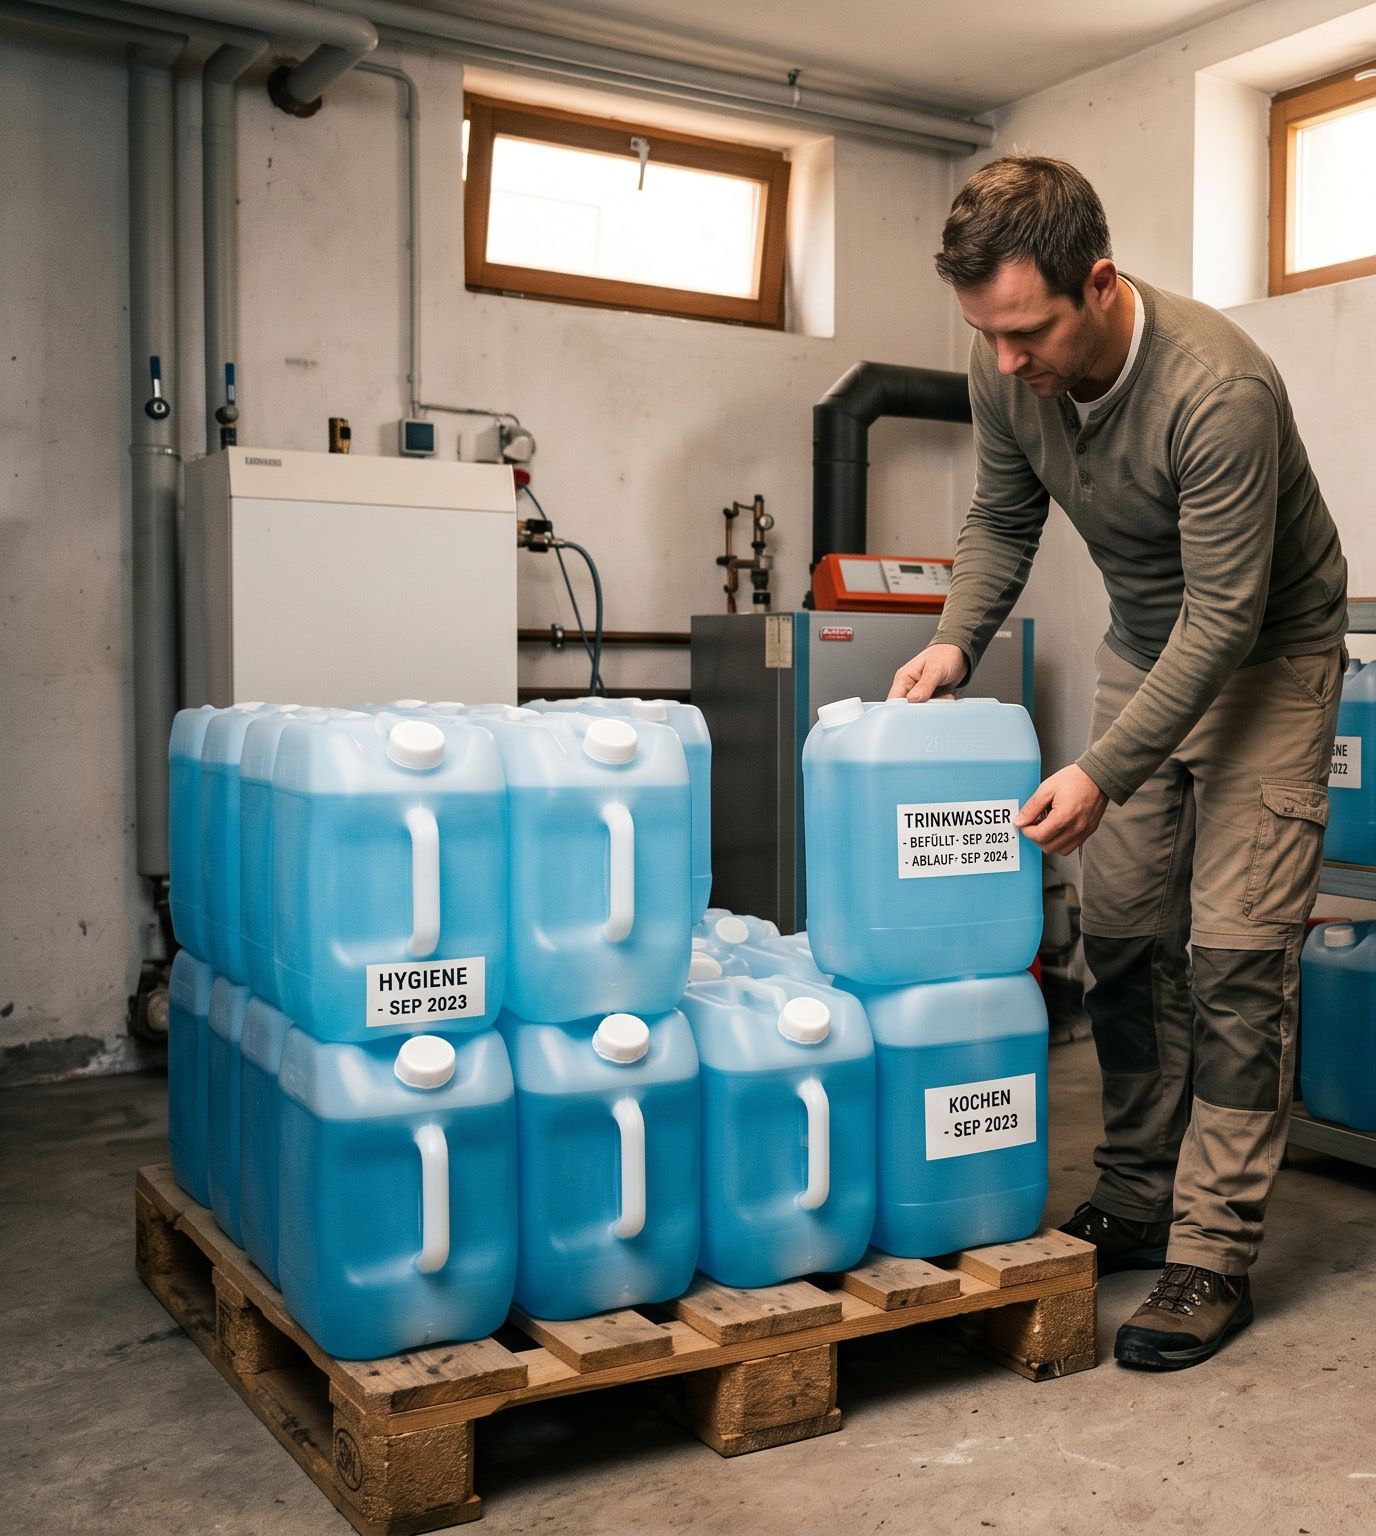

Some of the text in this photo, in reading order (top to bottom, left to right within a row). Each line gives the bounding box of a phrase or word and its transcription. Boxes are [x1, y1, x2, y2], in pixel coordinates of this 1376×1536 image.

[904, 808, 1011, 829] TRINKWASSER
[962, 834, 982, 845] SEP
[986, 832, 1009, 844] 2023
[961, 852, 981, 864] SEP
[983, 850, 1008, 862] 2024
[379, 967, 468, 991] HYGIENE
[389, 998, 422, 1015] SEP
[428, 995, 468, 1013] 2023
[949, 1089, 1011, 1113] KOCHEN
[954, 1120, 980, 1138] SEP
[985, 1114, 1018, 1133] 2023
